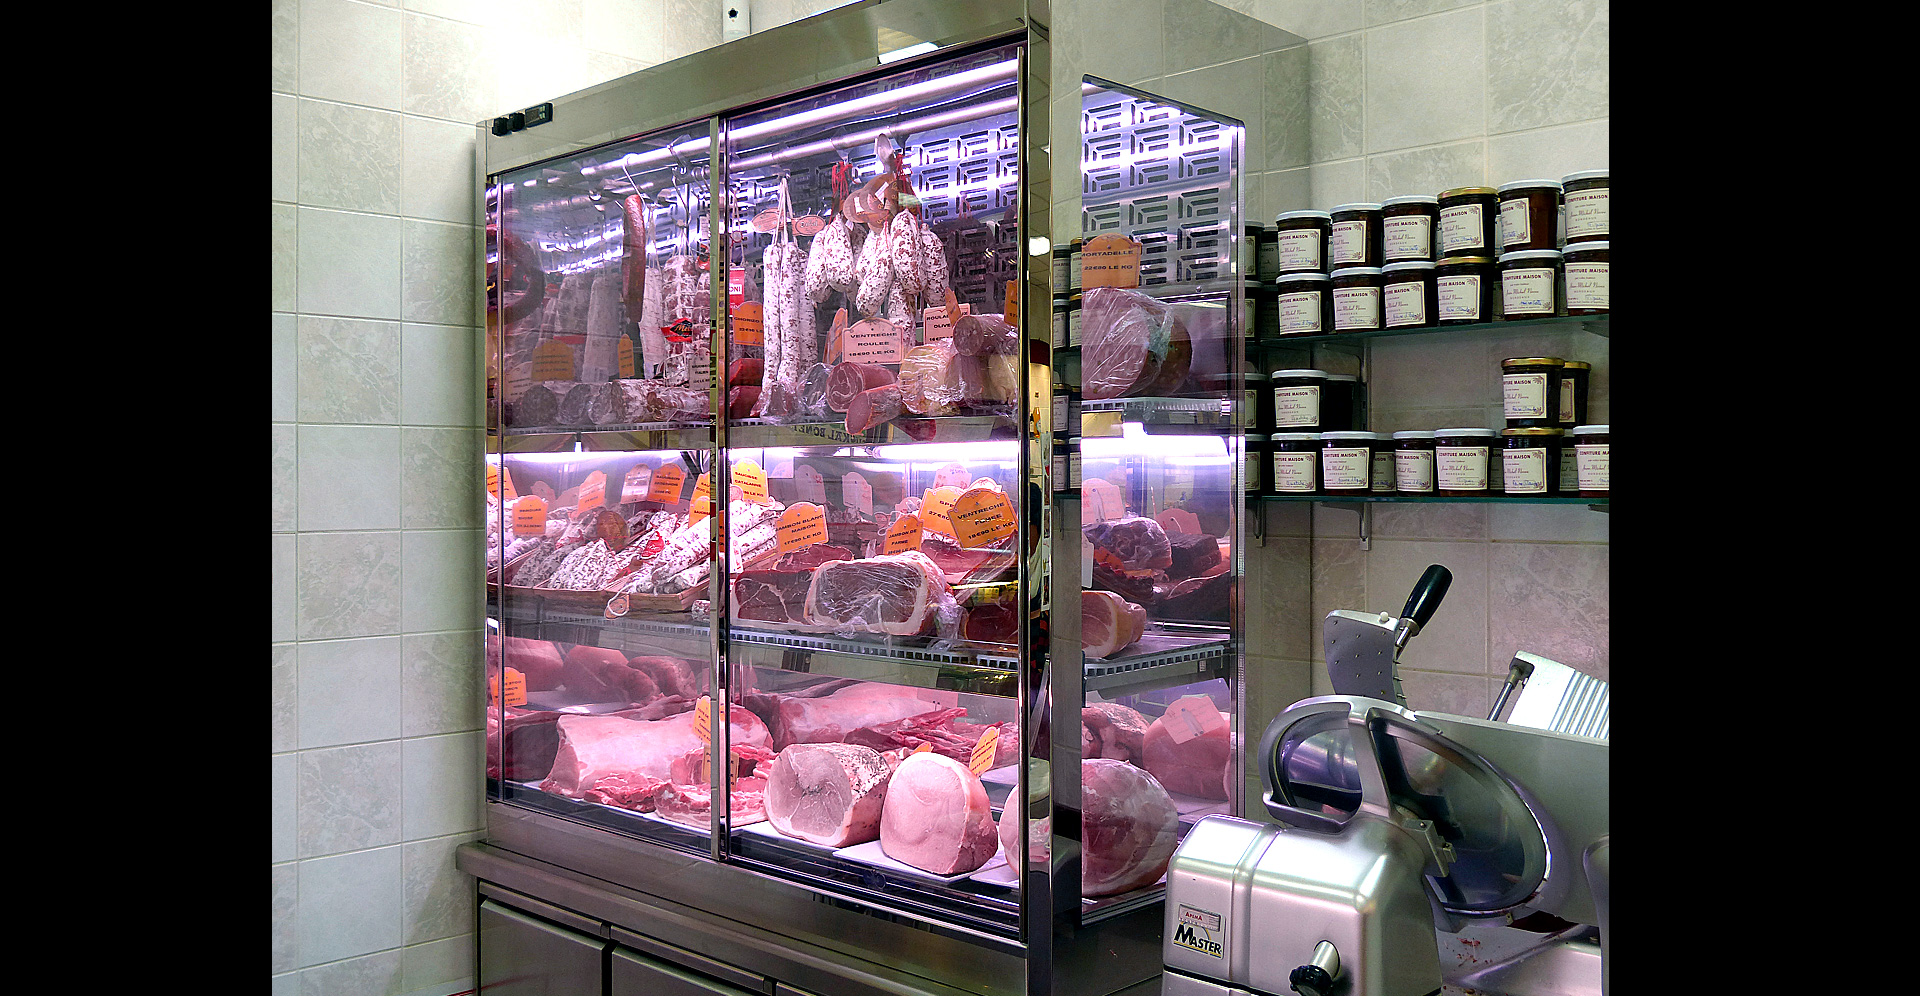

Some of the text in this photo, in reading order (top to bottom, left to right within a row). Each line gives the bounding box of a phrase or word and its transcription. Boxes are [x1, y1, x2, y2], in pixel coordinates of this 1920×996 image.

[850, 332, 898, 340] VENTRECHE
[957, 502, 1005, 520] VENTRECHE
[775, 514, 824, 531] JAMBON BLANC
[791, 523, 816, 533] MAISON
[991, 524, 1001, 533] LE
[1002, 521, 1015, 529] KG
[888, 530, 909, 539] JAMBON
[1174, 924, 1222, 954] MASTER
